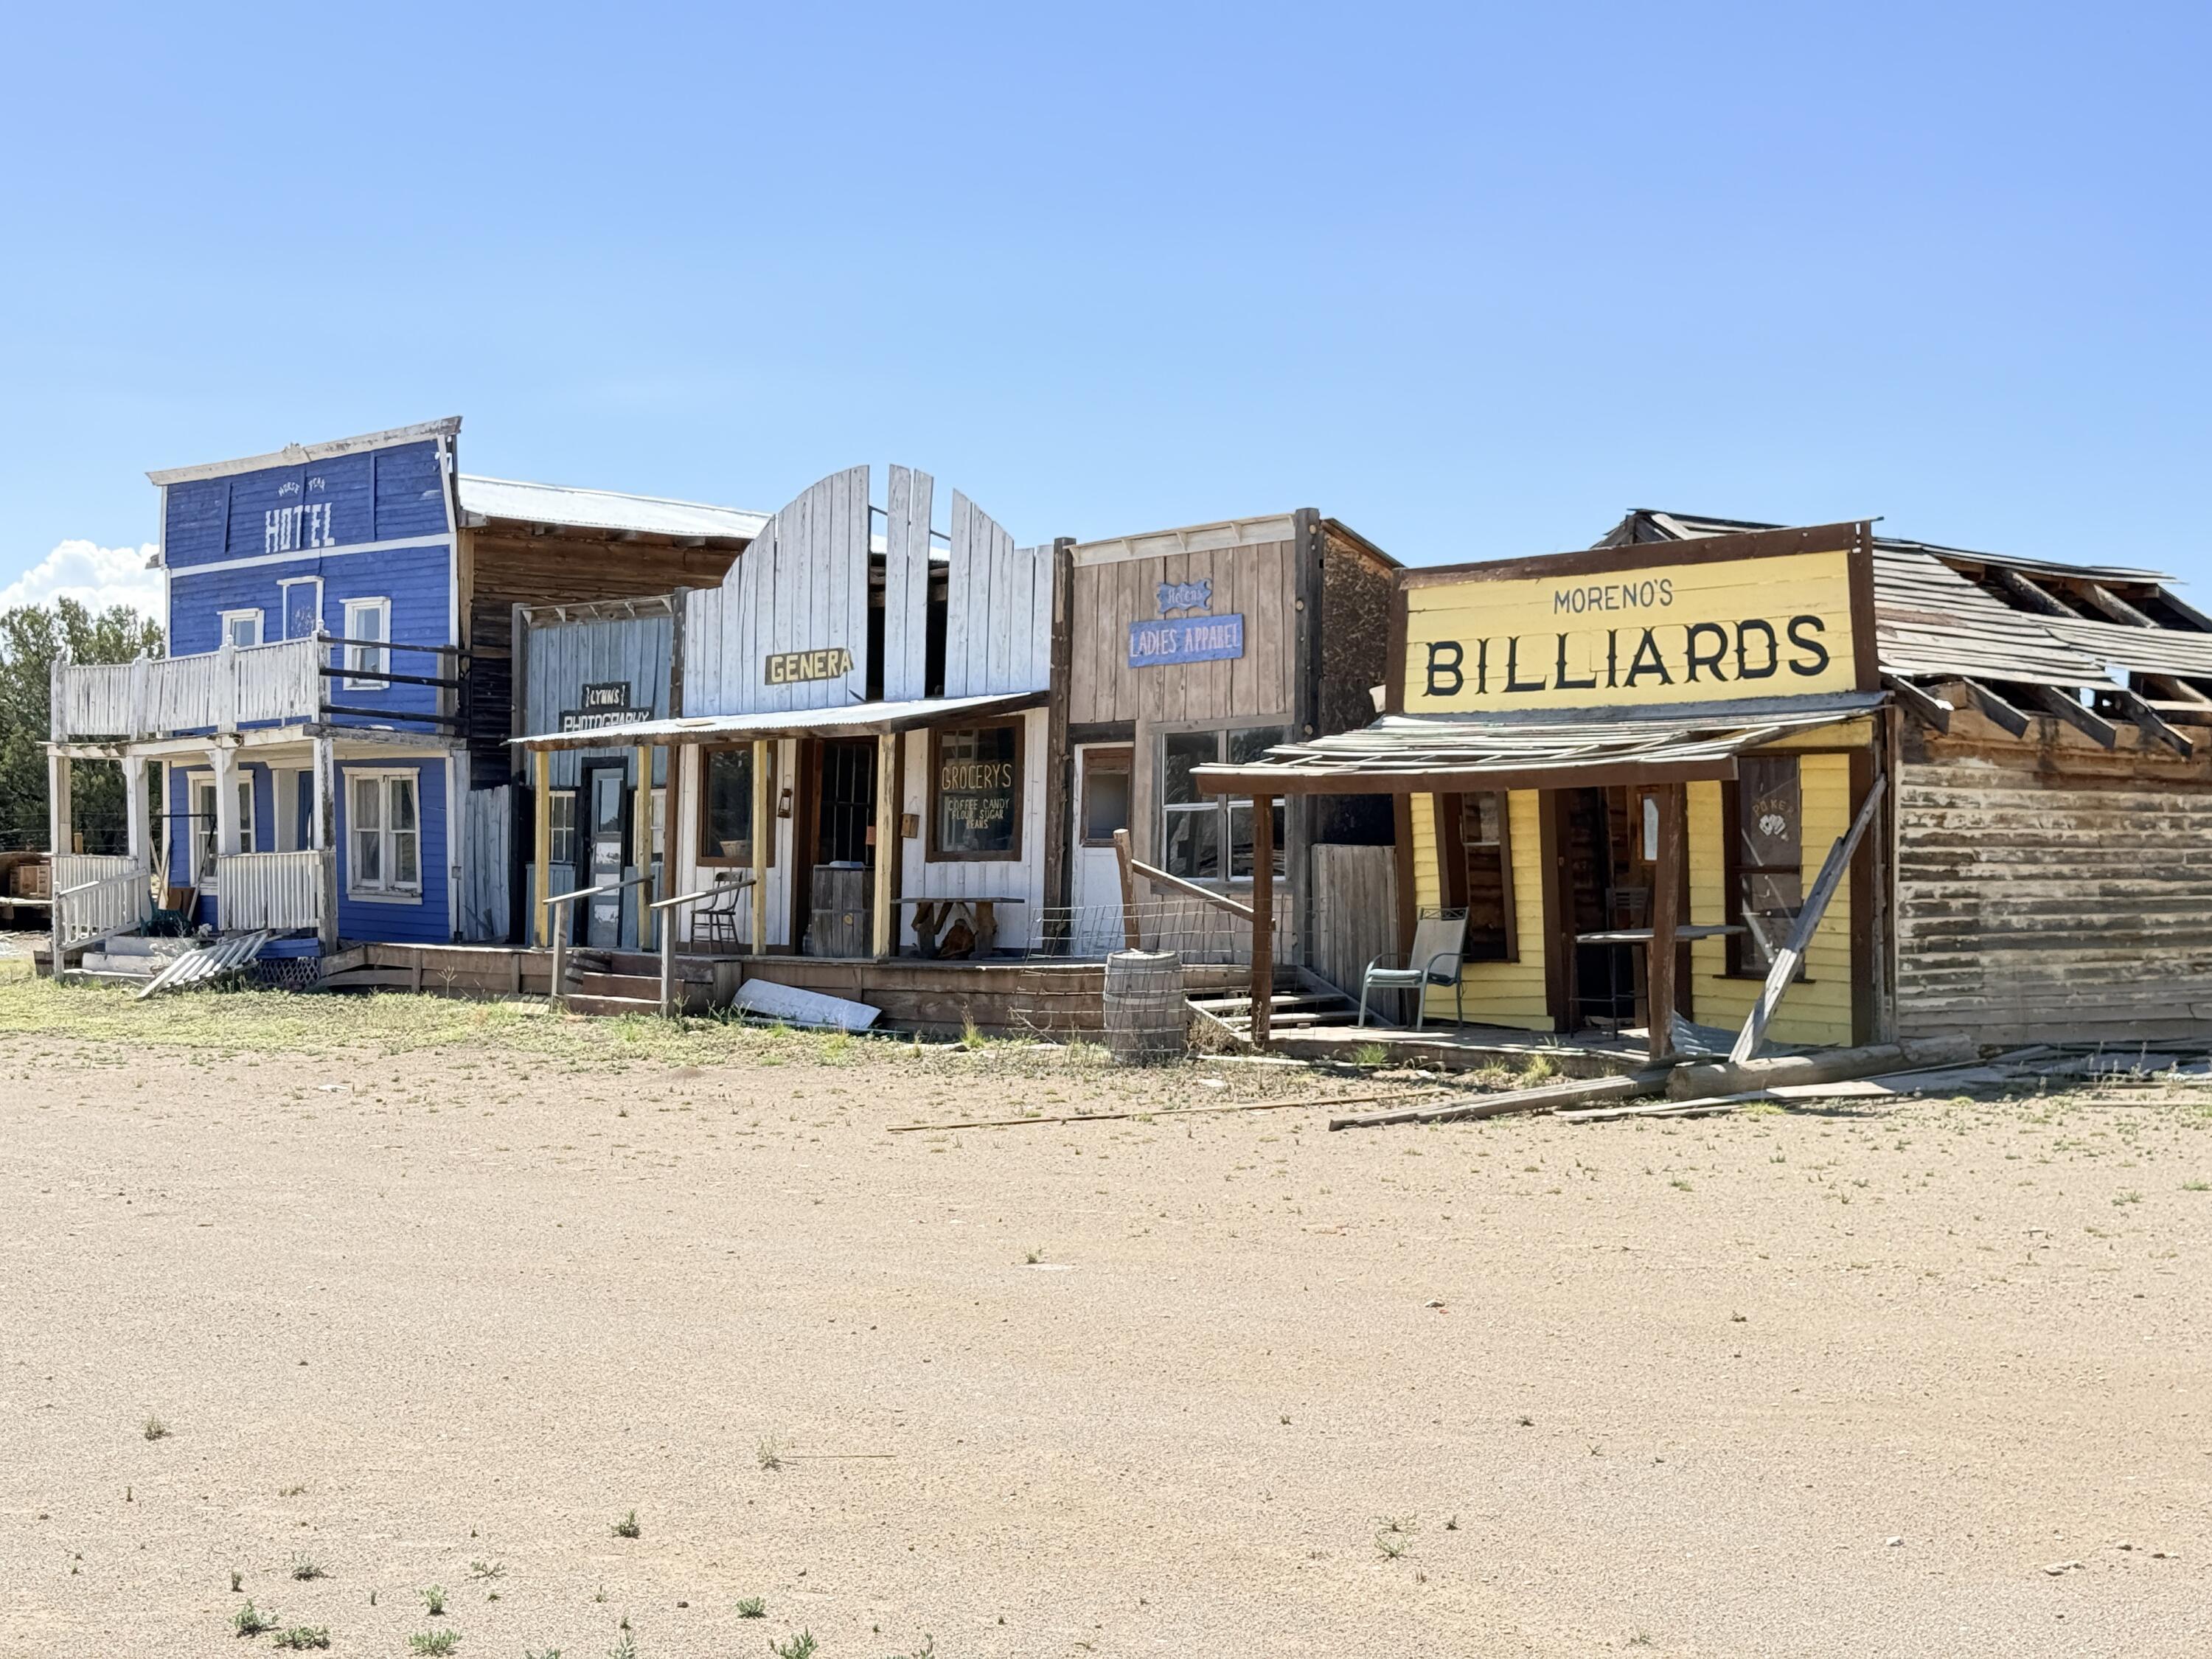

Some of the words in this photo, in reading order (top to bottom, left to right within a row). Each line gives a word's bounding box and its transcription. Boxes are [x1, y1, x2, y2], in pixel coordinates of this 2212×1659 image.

[265, 502, 335, 554] HOTEL
[1554, 579, 1673, 613] MORENO'S
[1130, 627, 1178, 657] LADIES
[1184, 624, 1240, 653] APPAREL
[1422, 615, 1830, 697] BILLIARDS
[771, 650, 852, 683] GENERA
[942, 763, 1012, 790] GROCERYS
[948, 799, 978, 810] COFFEE
[983, 797, 1009, 810] CANDY
[951, 810, 973, 820] FLOUR
[979, 809, 1004, 819] SUGAR
[966, 819, 989, 829] BEANS
